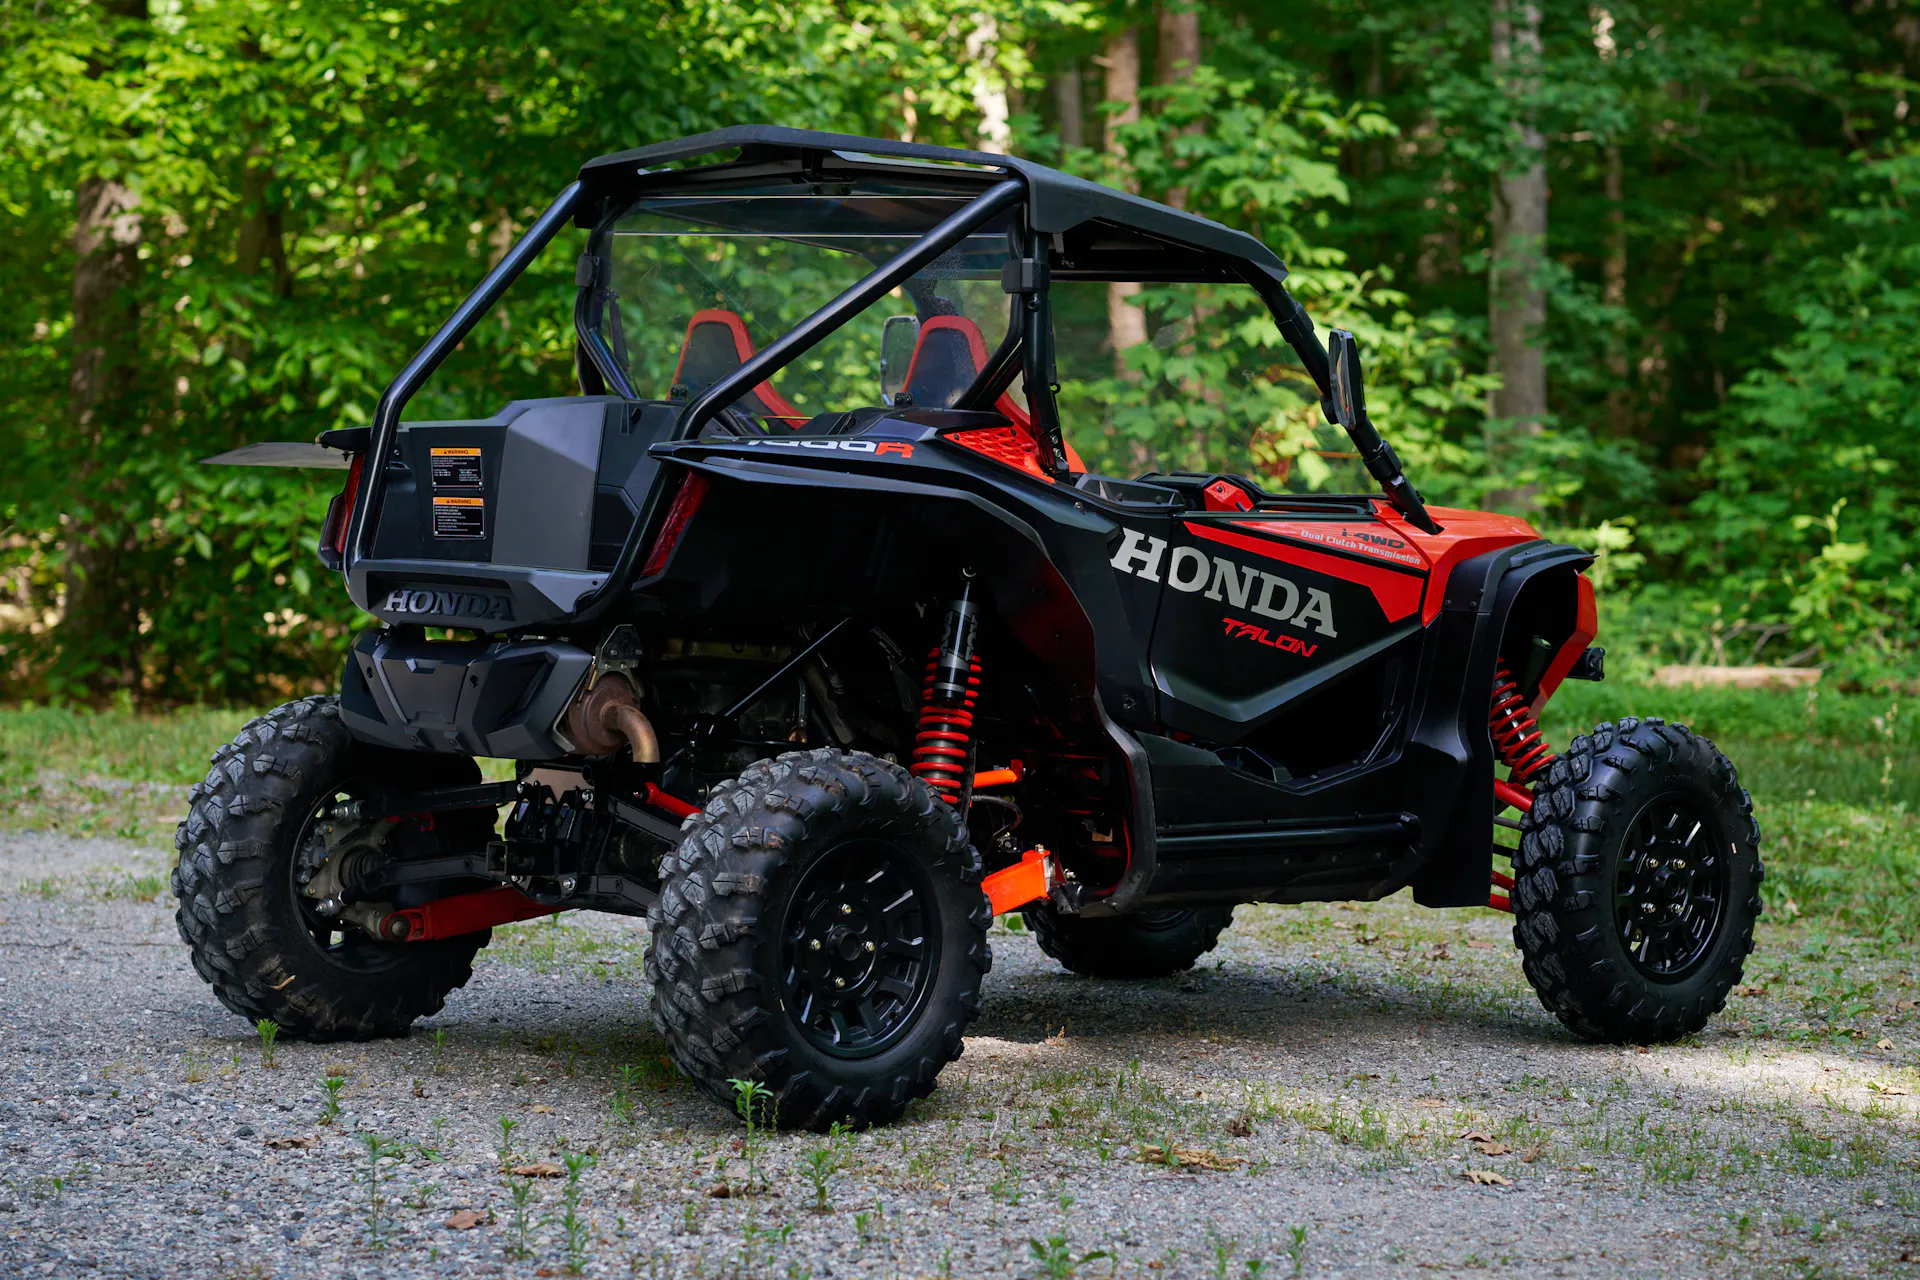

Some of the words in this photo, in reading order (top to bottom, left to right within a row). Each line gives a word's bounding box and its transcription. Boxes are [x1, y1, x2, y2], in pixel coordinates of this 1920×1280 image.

[1300, 529, 1324, 542] Dual
[1325, 534, 1357, 550] Clutch
[1357, 542, 1421, 566] Transmission
[1109, 526, 1339, 639] HONDA
[383, 589, 517, 621] HONDA
[1221, 617, 1319, 658] TALON
